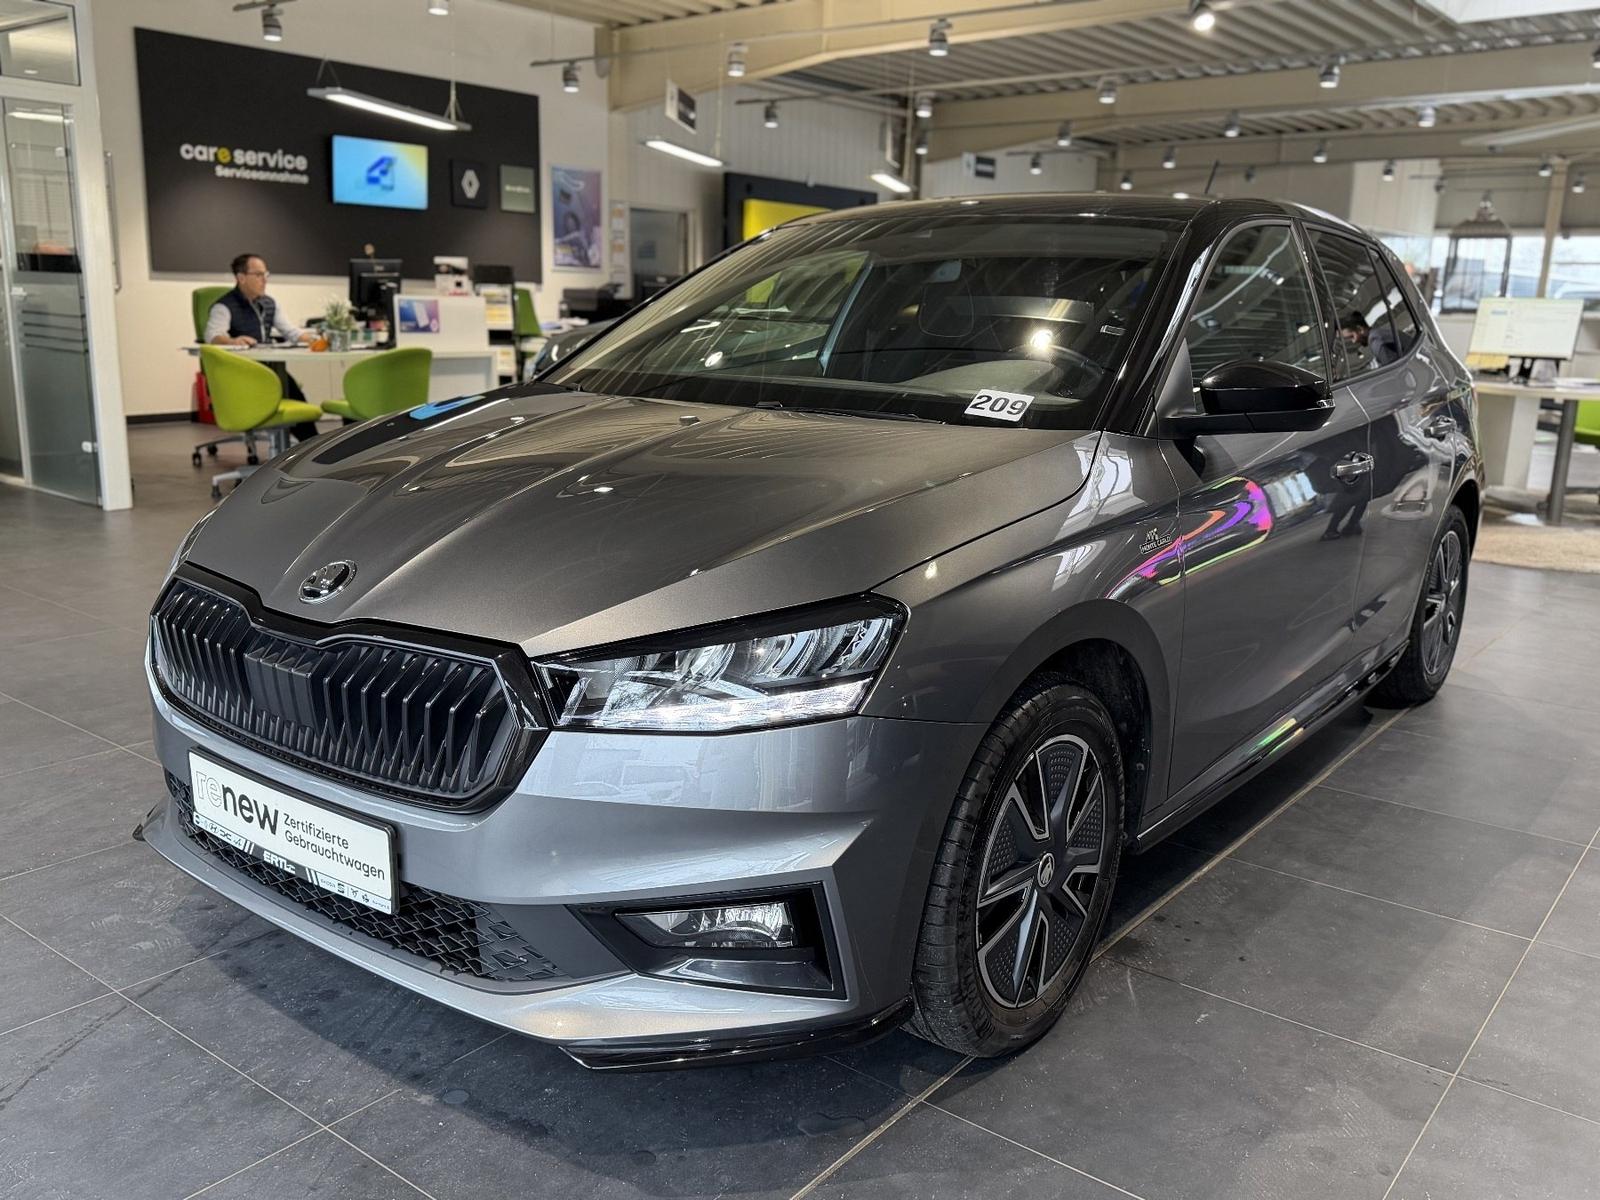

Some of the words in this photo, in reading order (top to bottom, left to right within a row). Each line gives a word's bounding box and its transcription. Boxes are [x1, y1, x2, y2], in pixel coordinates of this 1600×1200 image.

[180, 144, 231, 163] care
[233, 148, 308, 171] service
[969, 395, 1027, 415] 209
[196, 771, 278, 835] renew
[283, 813, 349, 849] Zertifizierte
[285, 830, 385, 880] Gebrauchtwagen
